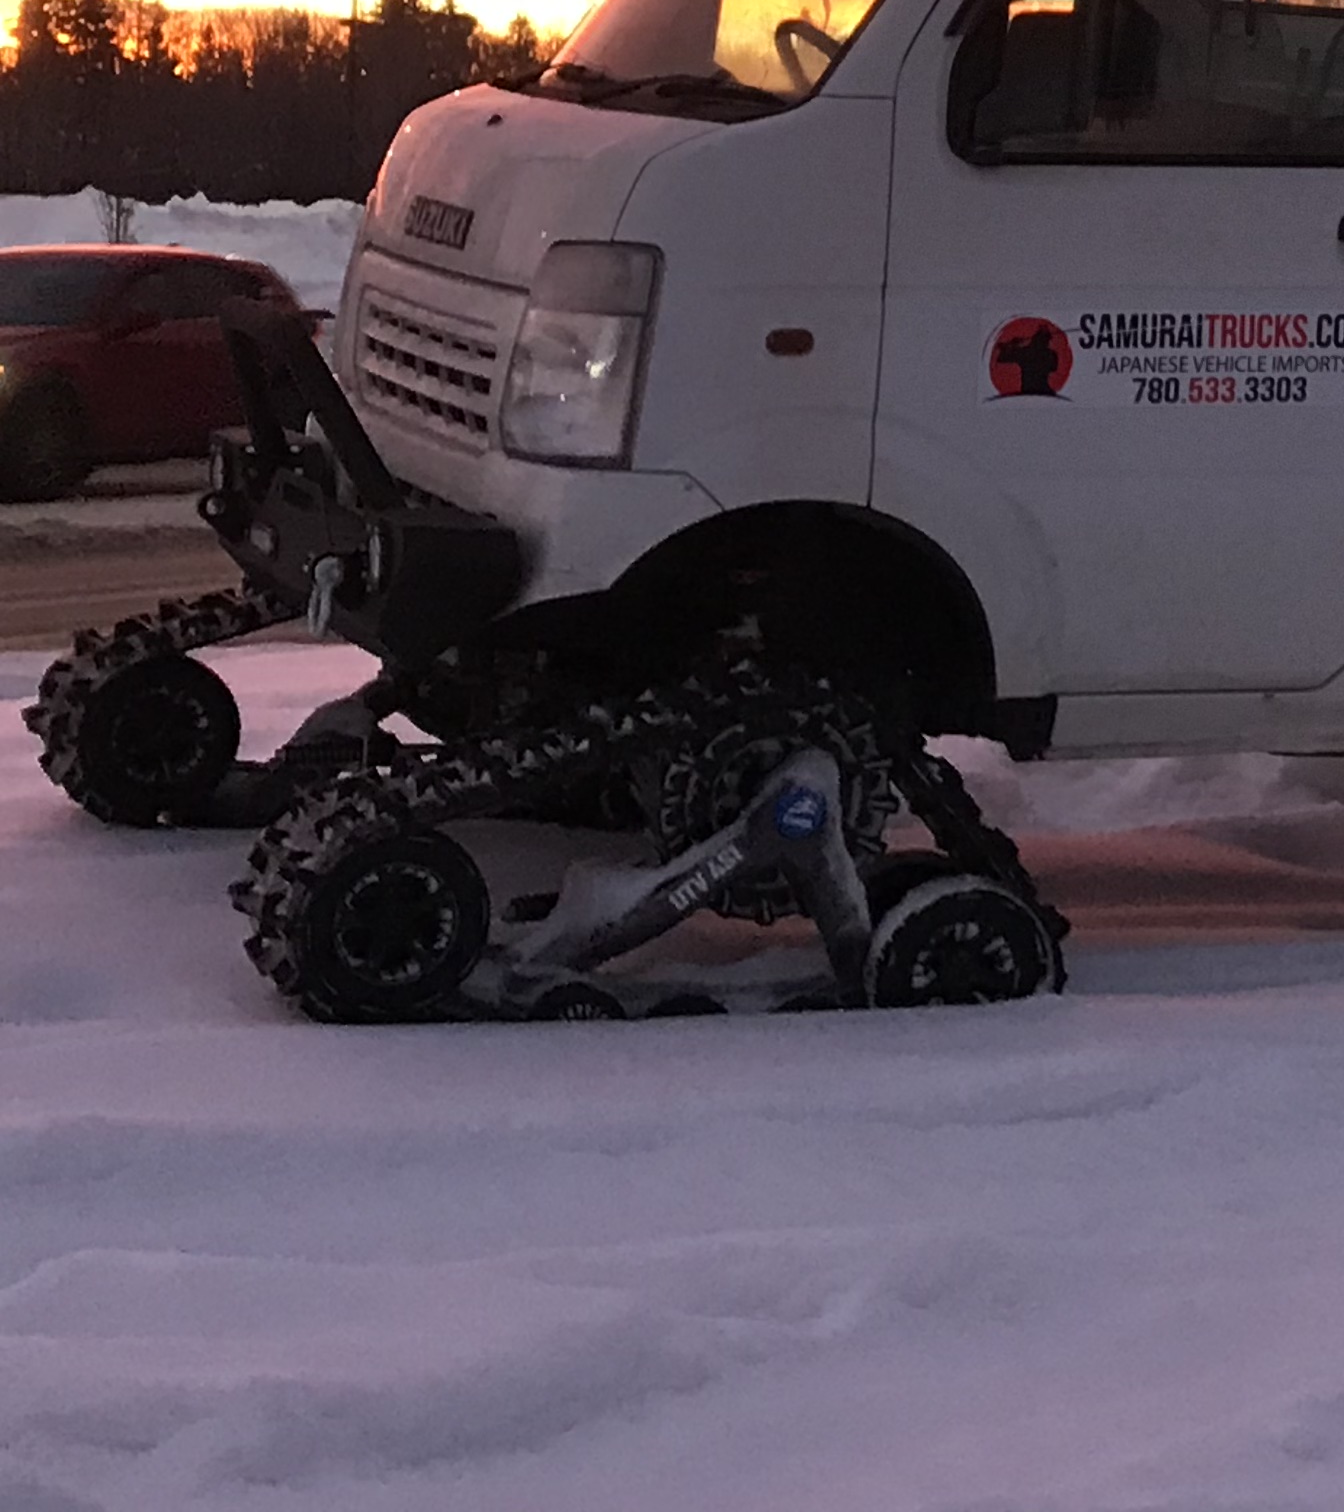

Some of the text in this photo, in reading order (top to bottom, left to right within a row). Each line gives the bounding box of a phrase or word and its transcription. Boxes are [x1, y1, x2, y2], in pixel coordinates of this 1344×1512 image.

[405, 198, 470, 246] SUZUKI
[1097, 355, 1189, 374] JAPANESE
[1193, 355, 1267, 373] VEHICLE
[1132, 376, 1308, 404] 780.533.3303
